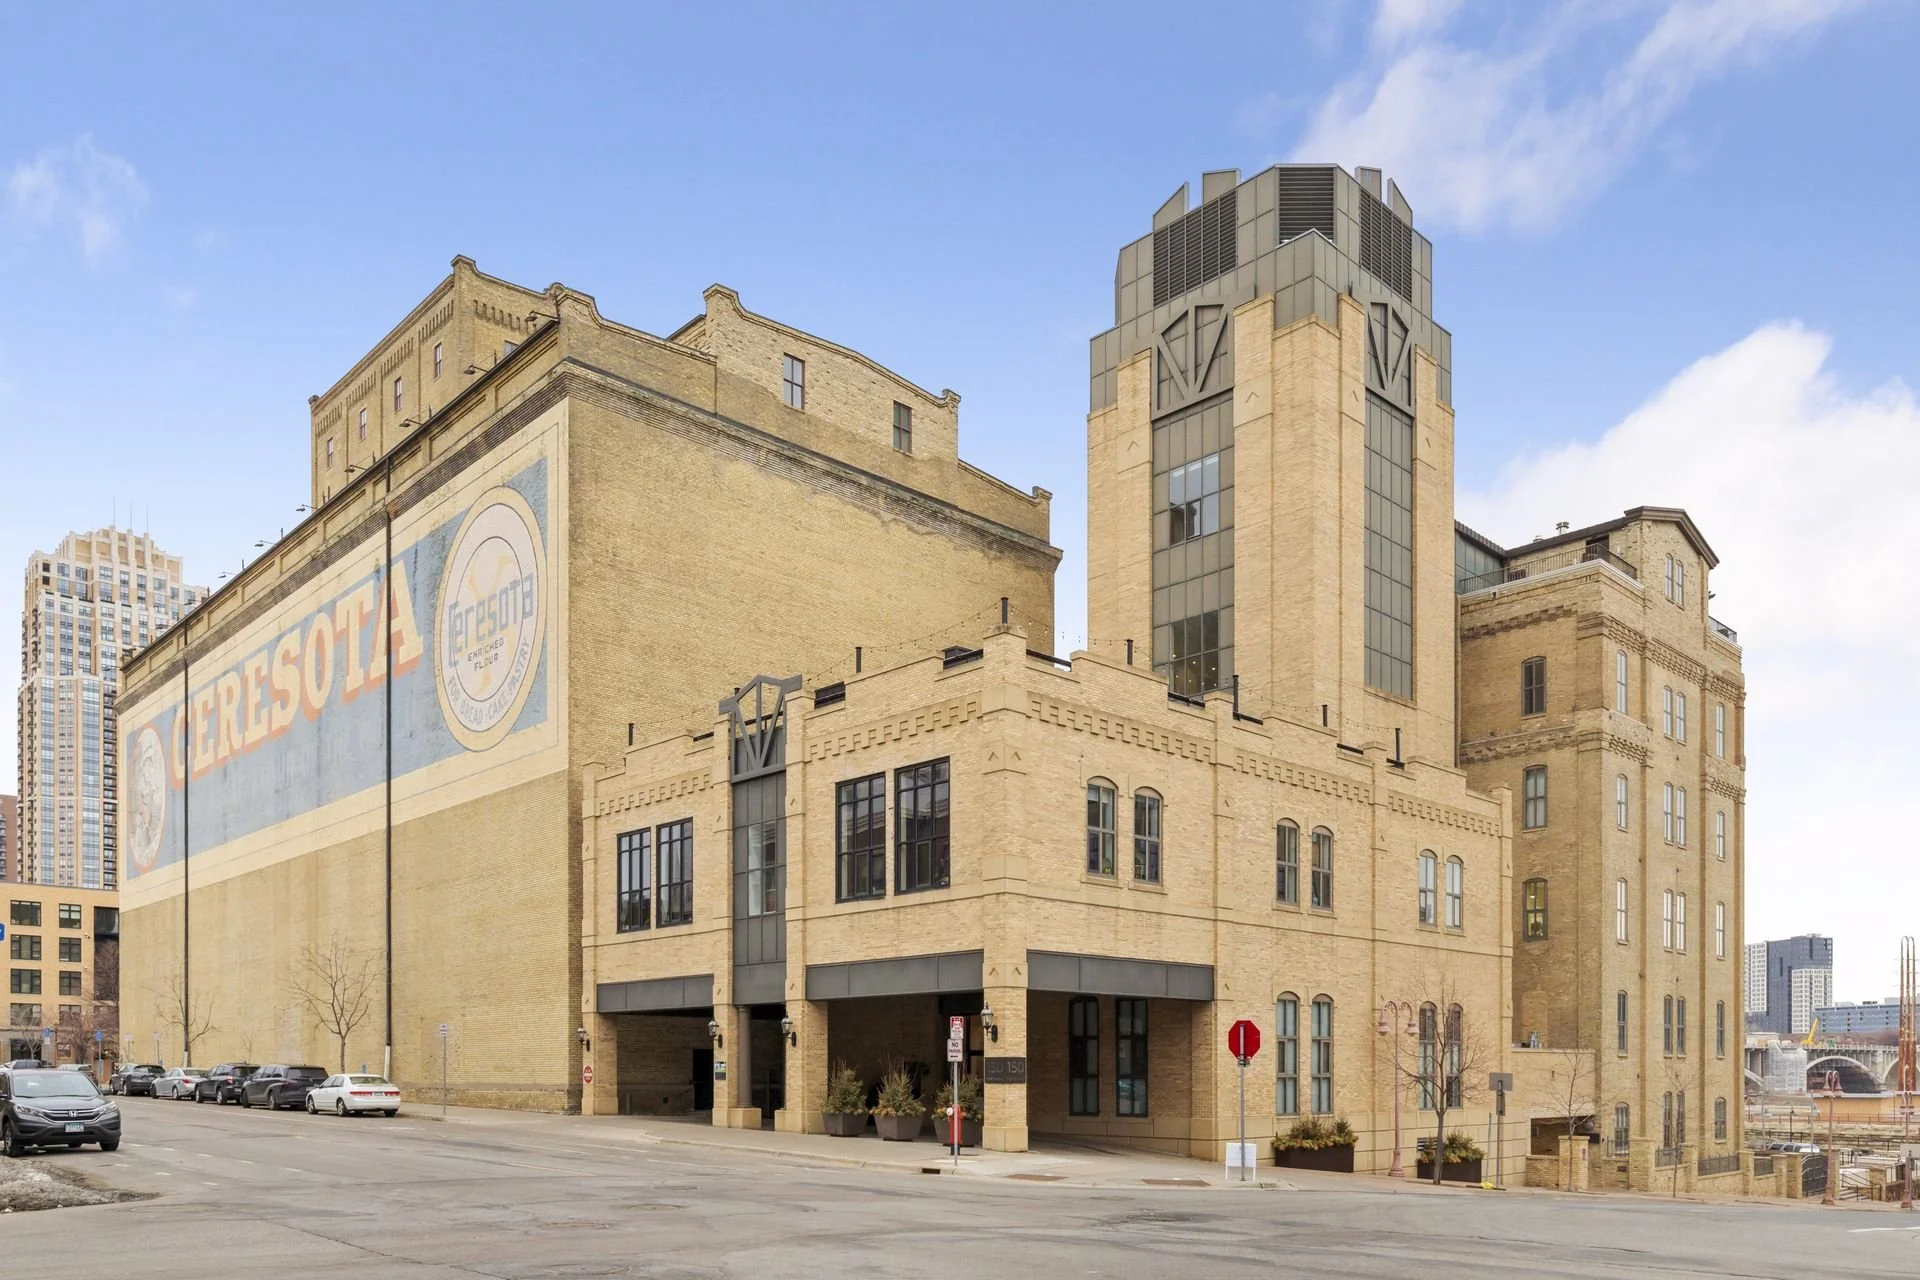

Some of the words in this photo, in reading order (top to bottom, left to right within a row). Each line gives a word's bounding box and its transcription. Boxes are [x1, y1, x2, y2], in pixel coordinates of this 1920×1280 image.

[467, 637, 505, 662] ENRICHED
[474, 652, 499, 672] FLOUR
[171, 558, 424, 789] CERESOTA
[447, 674, 461, 706] FOR
[507, 636, 530, 697] PASTRY
[1007, 1061, 1025, 1074] 150
